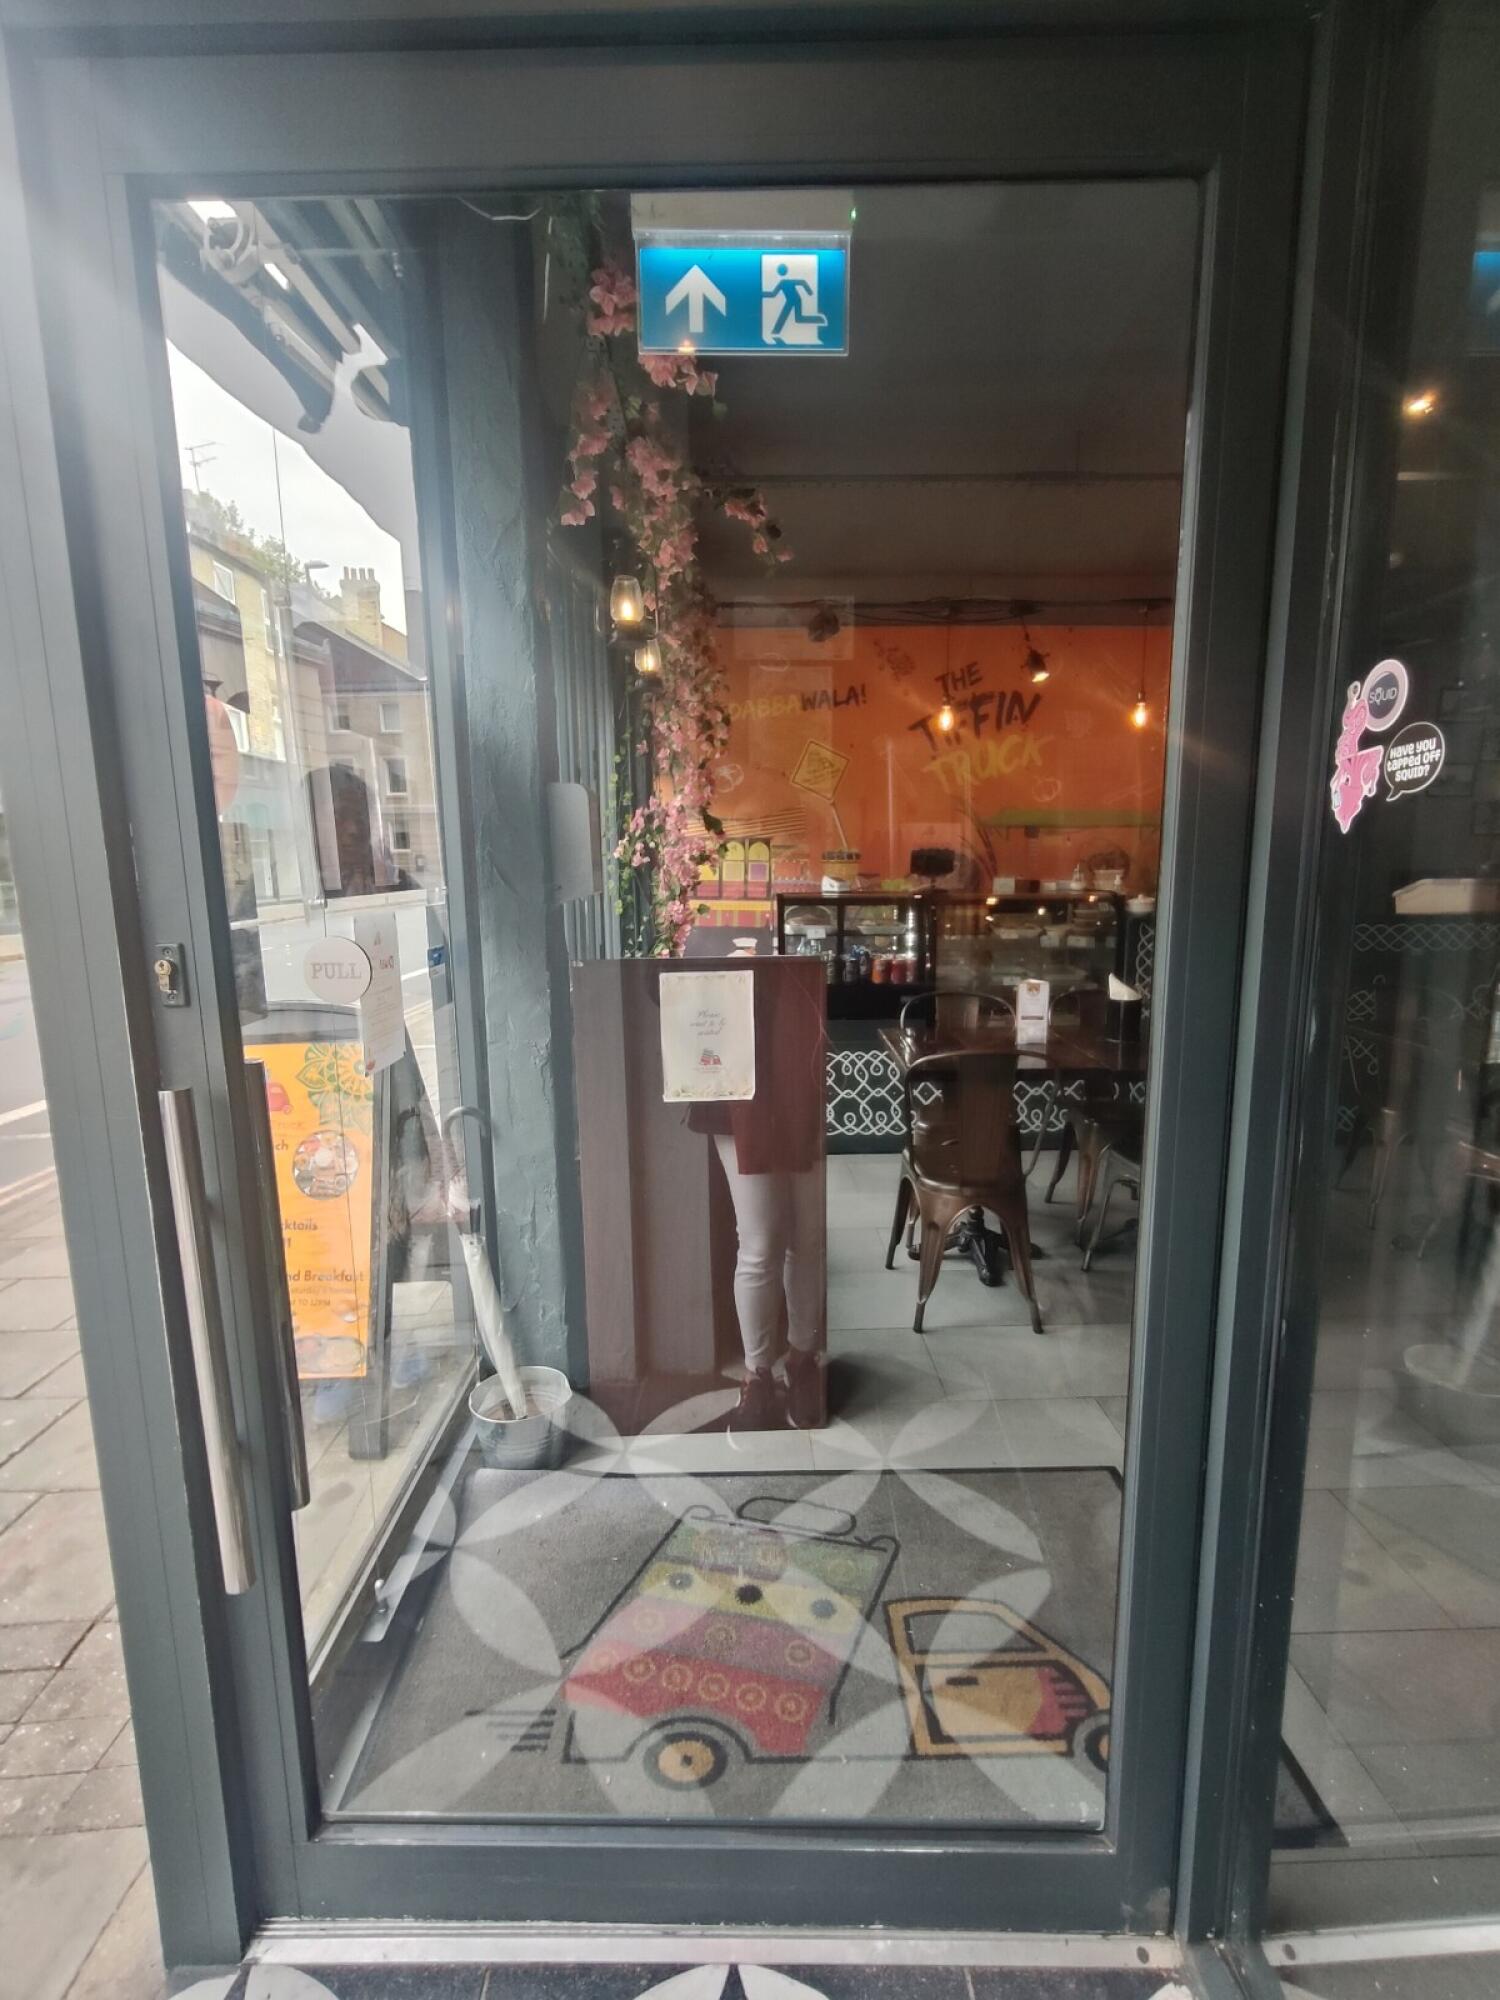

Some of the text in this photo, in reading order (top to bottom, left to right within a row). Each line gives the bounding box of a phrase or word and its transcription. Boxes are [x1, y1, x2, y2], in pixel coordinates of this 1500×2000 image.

[935, 661, 983, 696] THE
[1368, 687, 1398, 706] SQUID
[908, 689, 1042, 752] TFFIN
[925, 735, 1048, 788] TRUCK
[1394, 764, 1431, 782] SQUID?
[310, 962, 362, 980] PULL
